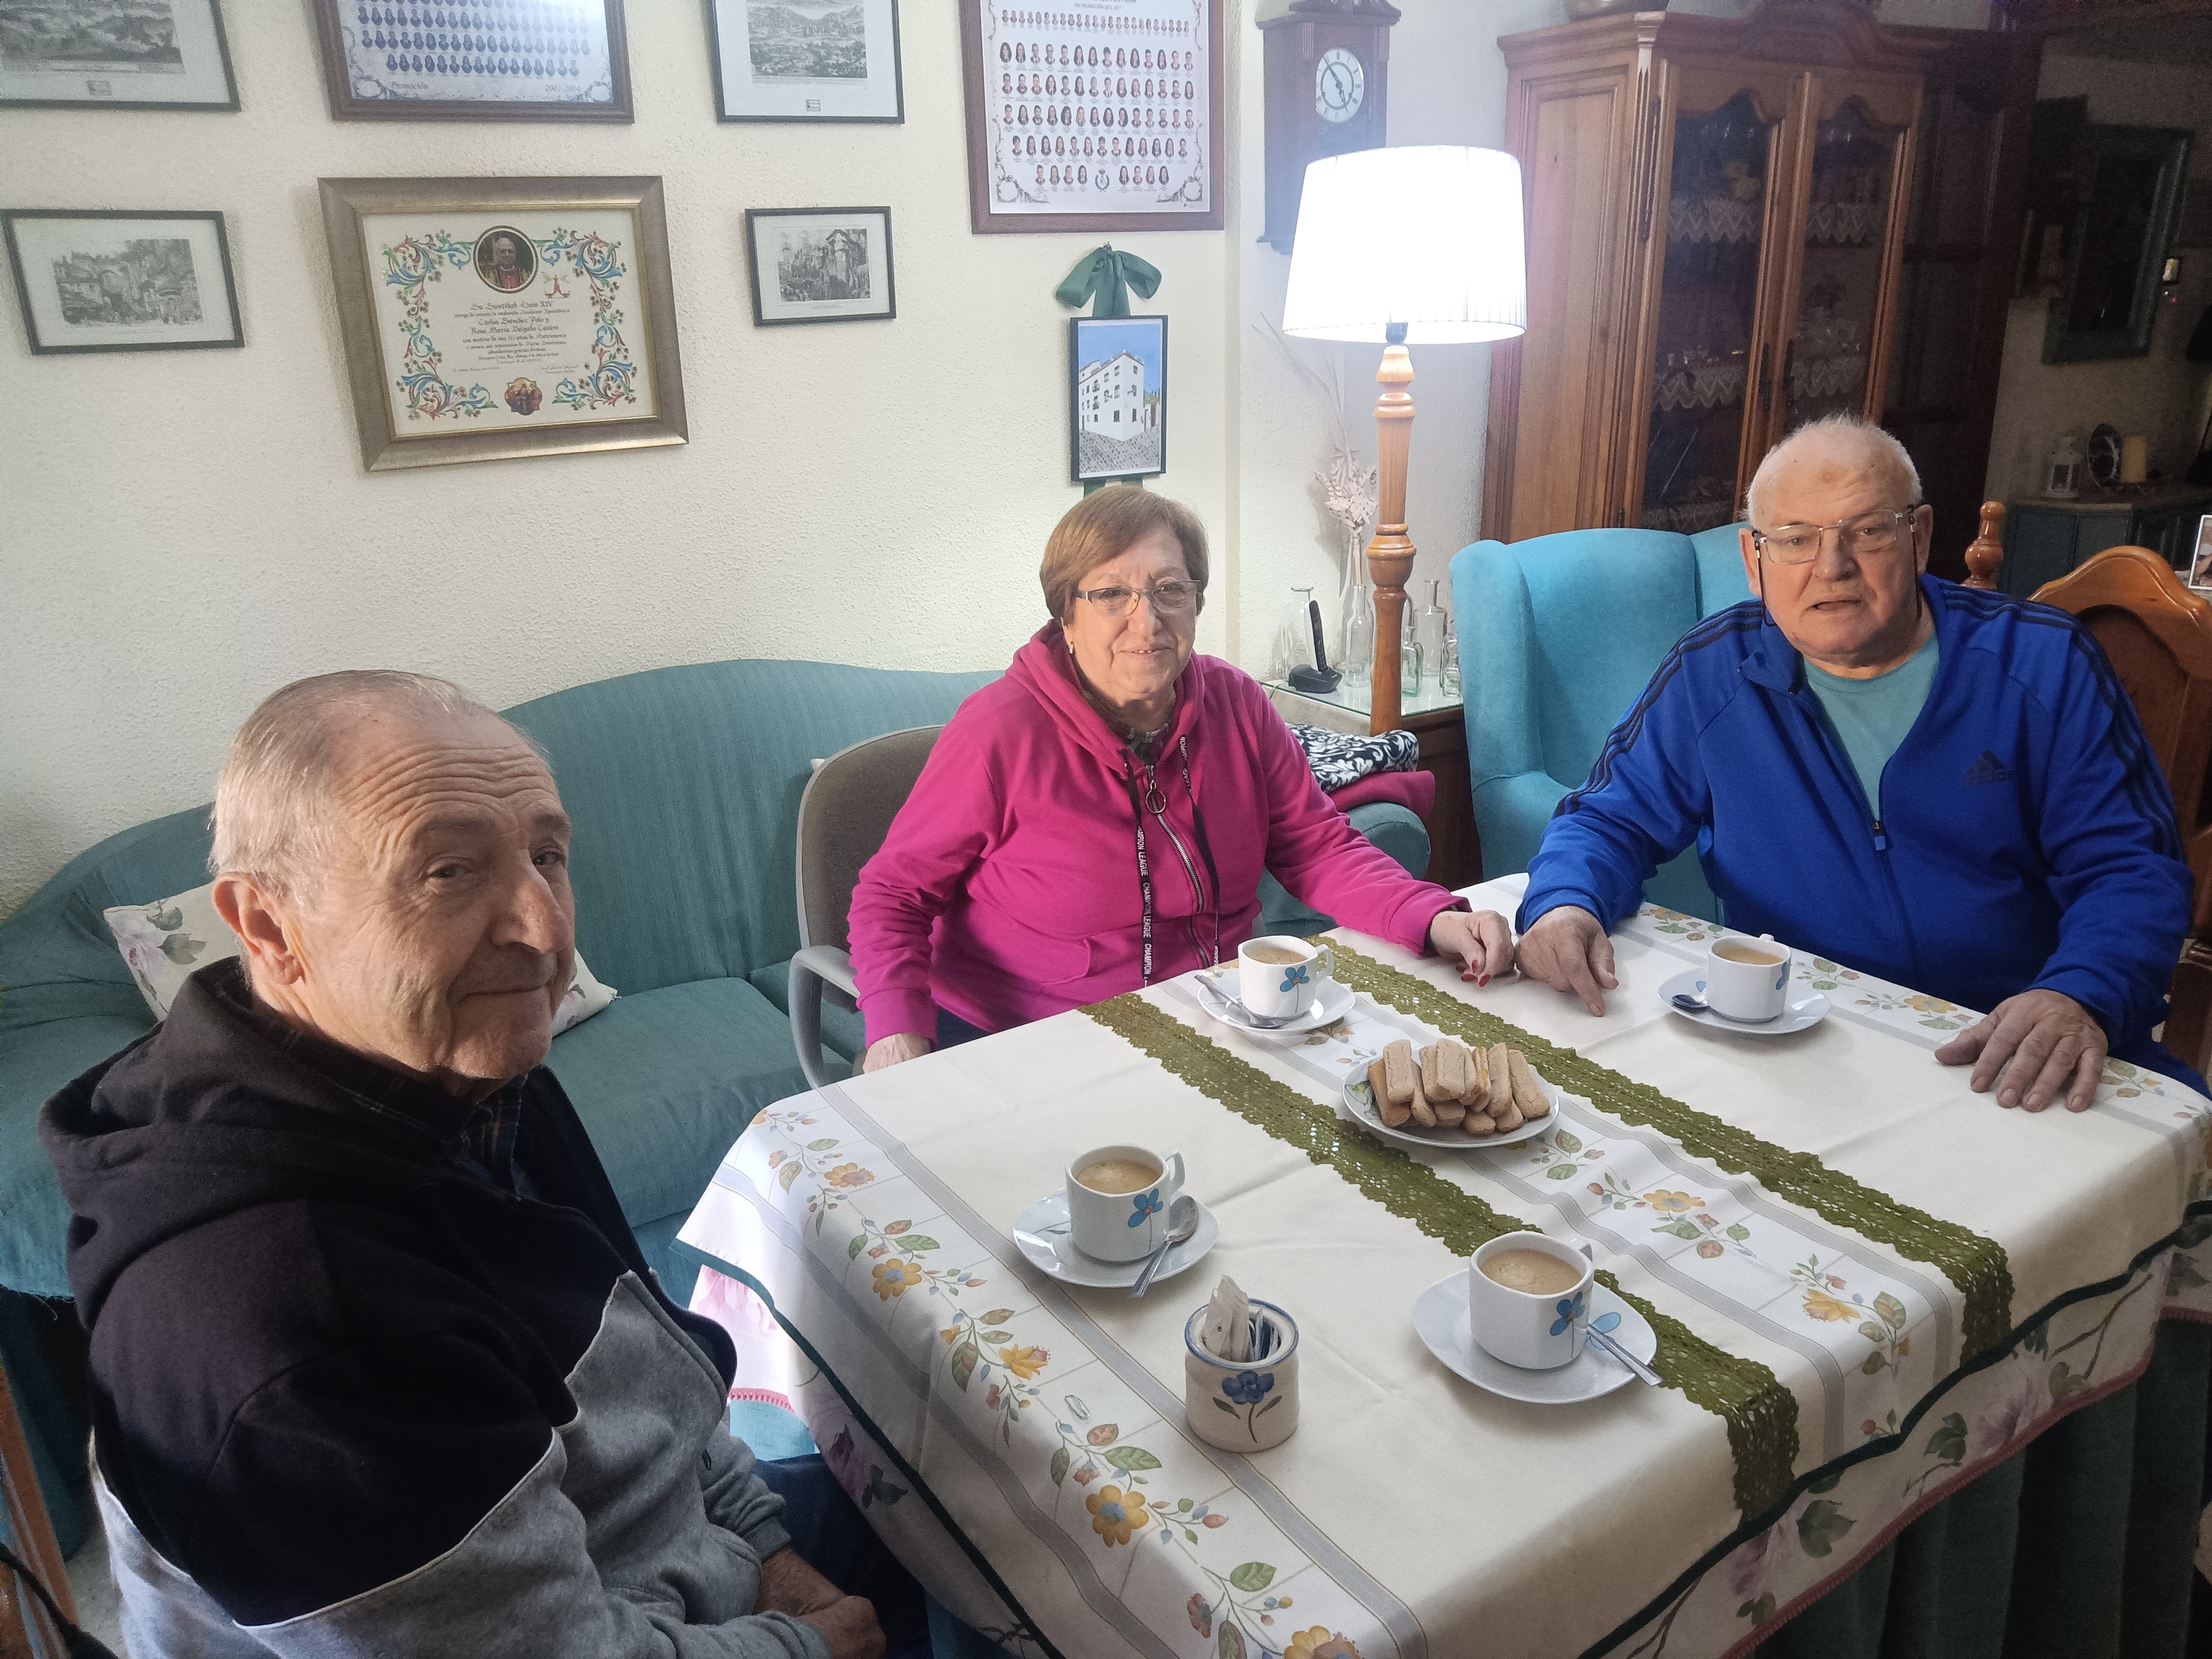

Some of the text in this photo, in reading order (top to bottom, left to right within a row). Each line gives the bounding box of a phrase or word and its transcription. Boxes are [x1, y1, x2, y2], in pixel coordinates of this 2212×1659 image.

[391, 81, 428, 89] Promoción
[1138, 852, 1148, 876] LEAGUE
[1142, 882, 1152, 915] CHAMPION
[1143, 915, 1152, 938] LEAGUE
[1144, 943, 1152, 974] CHAMPION
